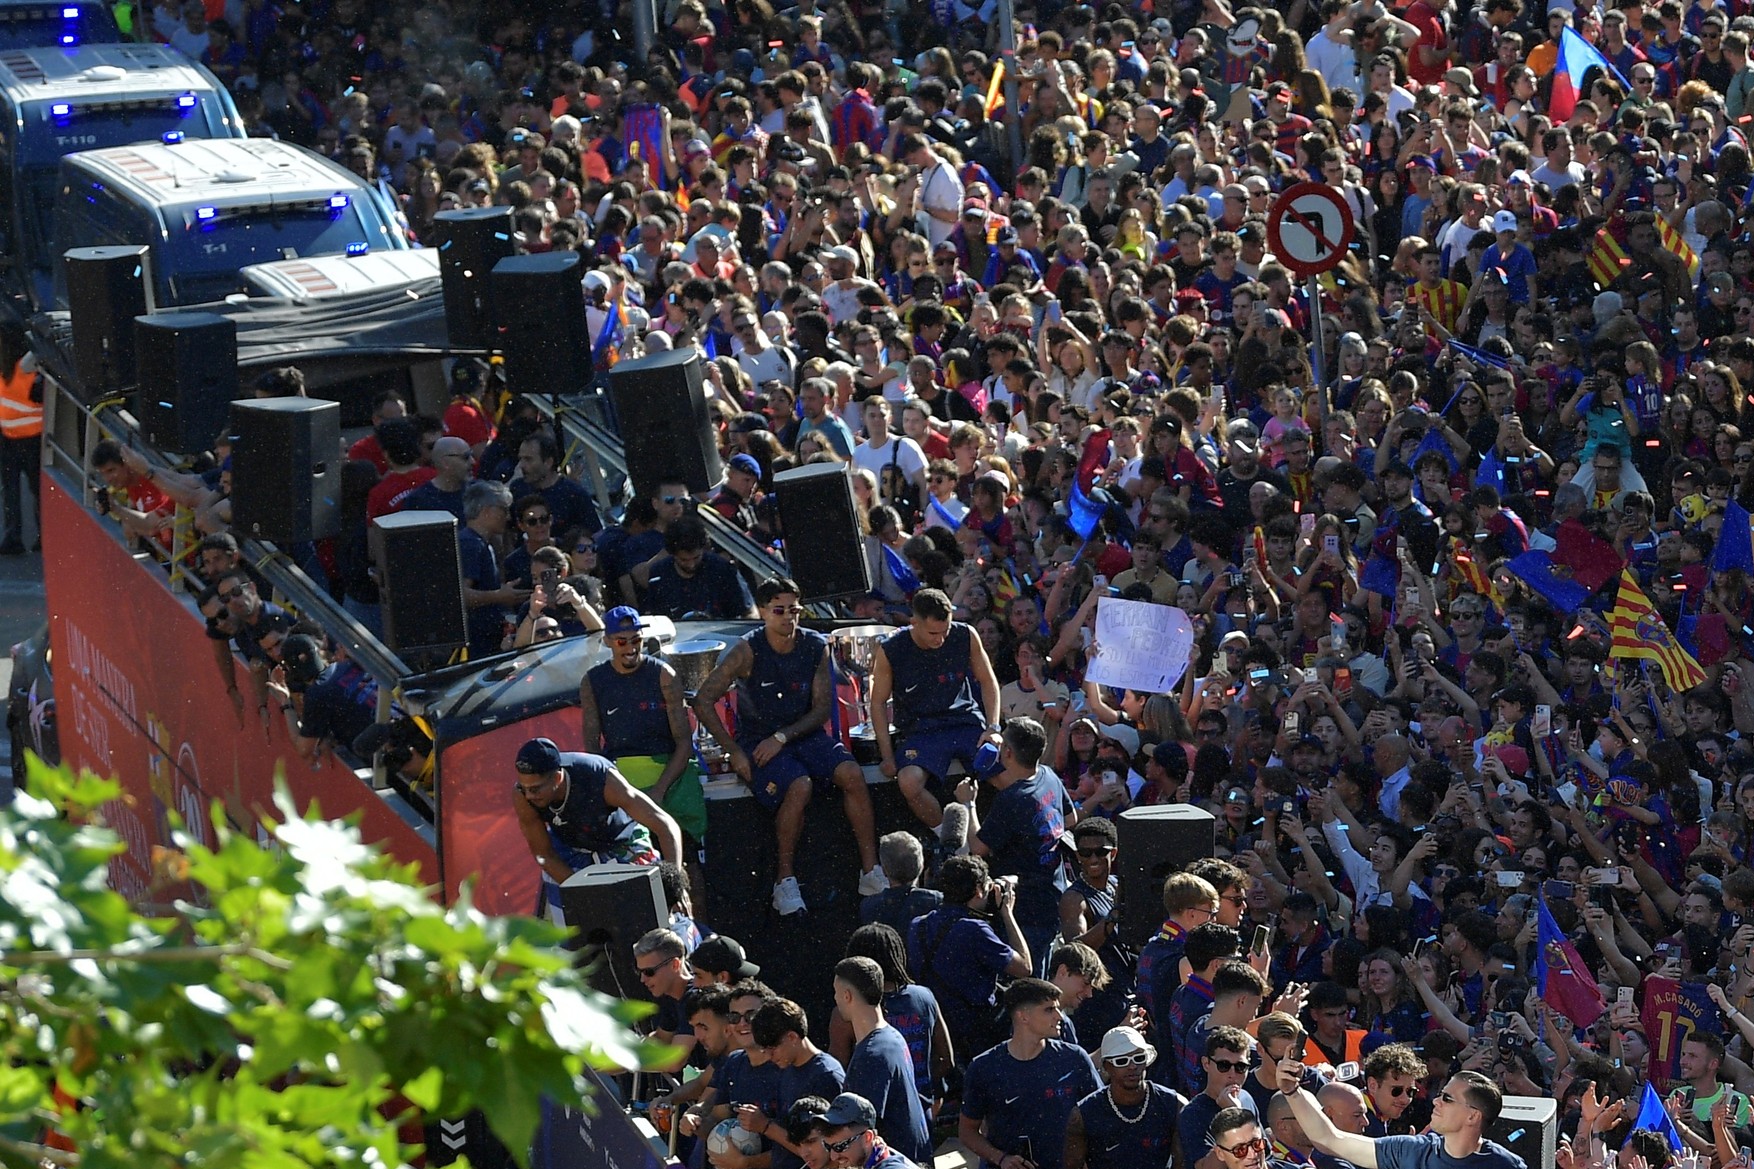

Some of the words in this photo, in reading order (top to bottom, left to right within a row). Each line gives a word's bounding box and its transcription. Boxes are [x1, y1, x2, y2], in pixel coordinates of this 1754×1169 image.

[57, 135, 97, 145] T-110
[203, 244, 227, 253] T-1
[1656, 1011, 1697, 1062] 17
